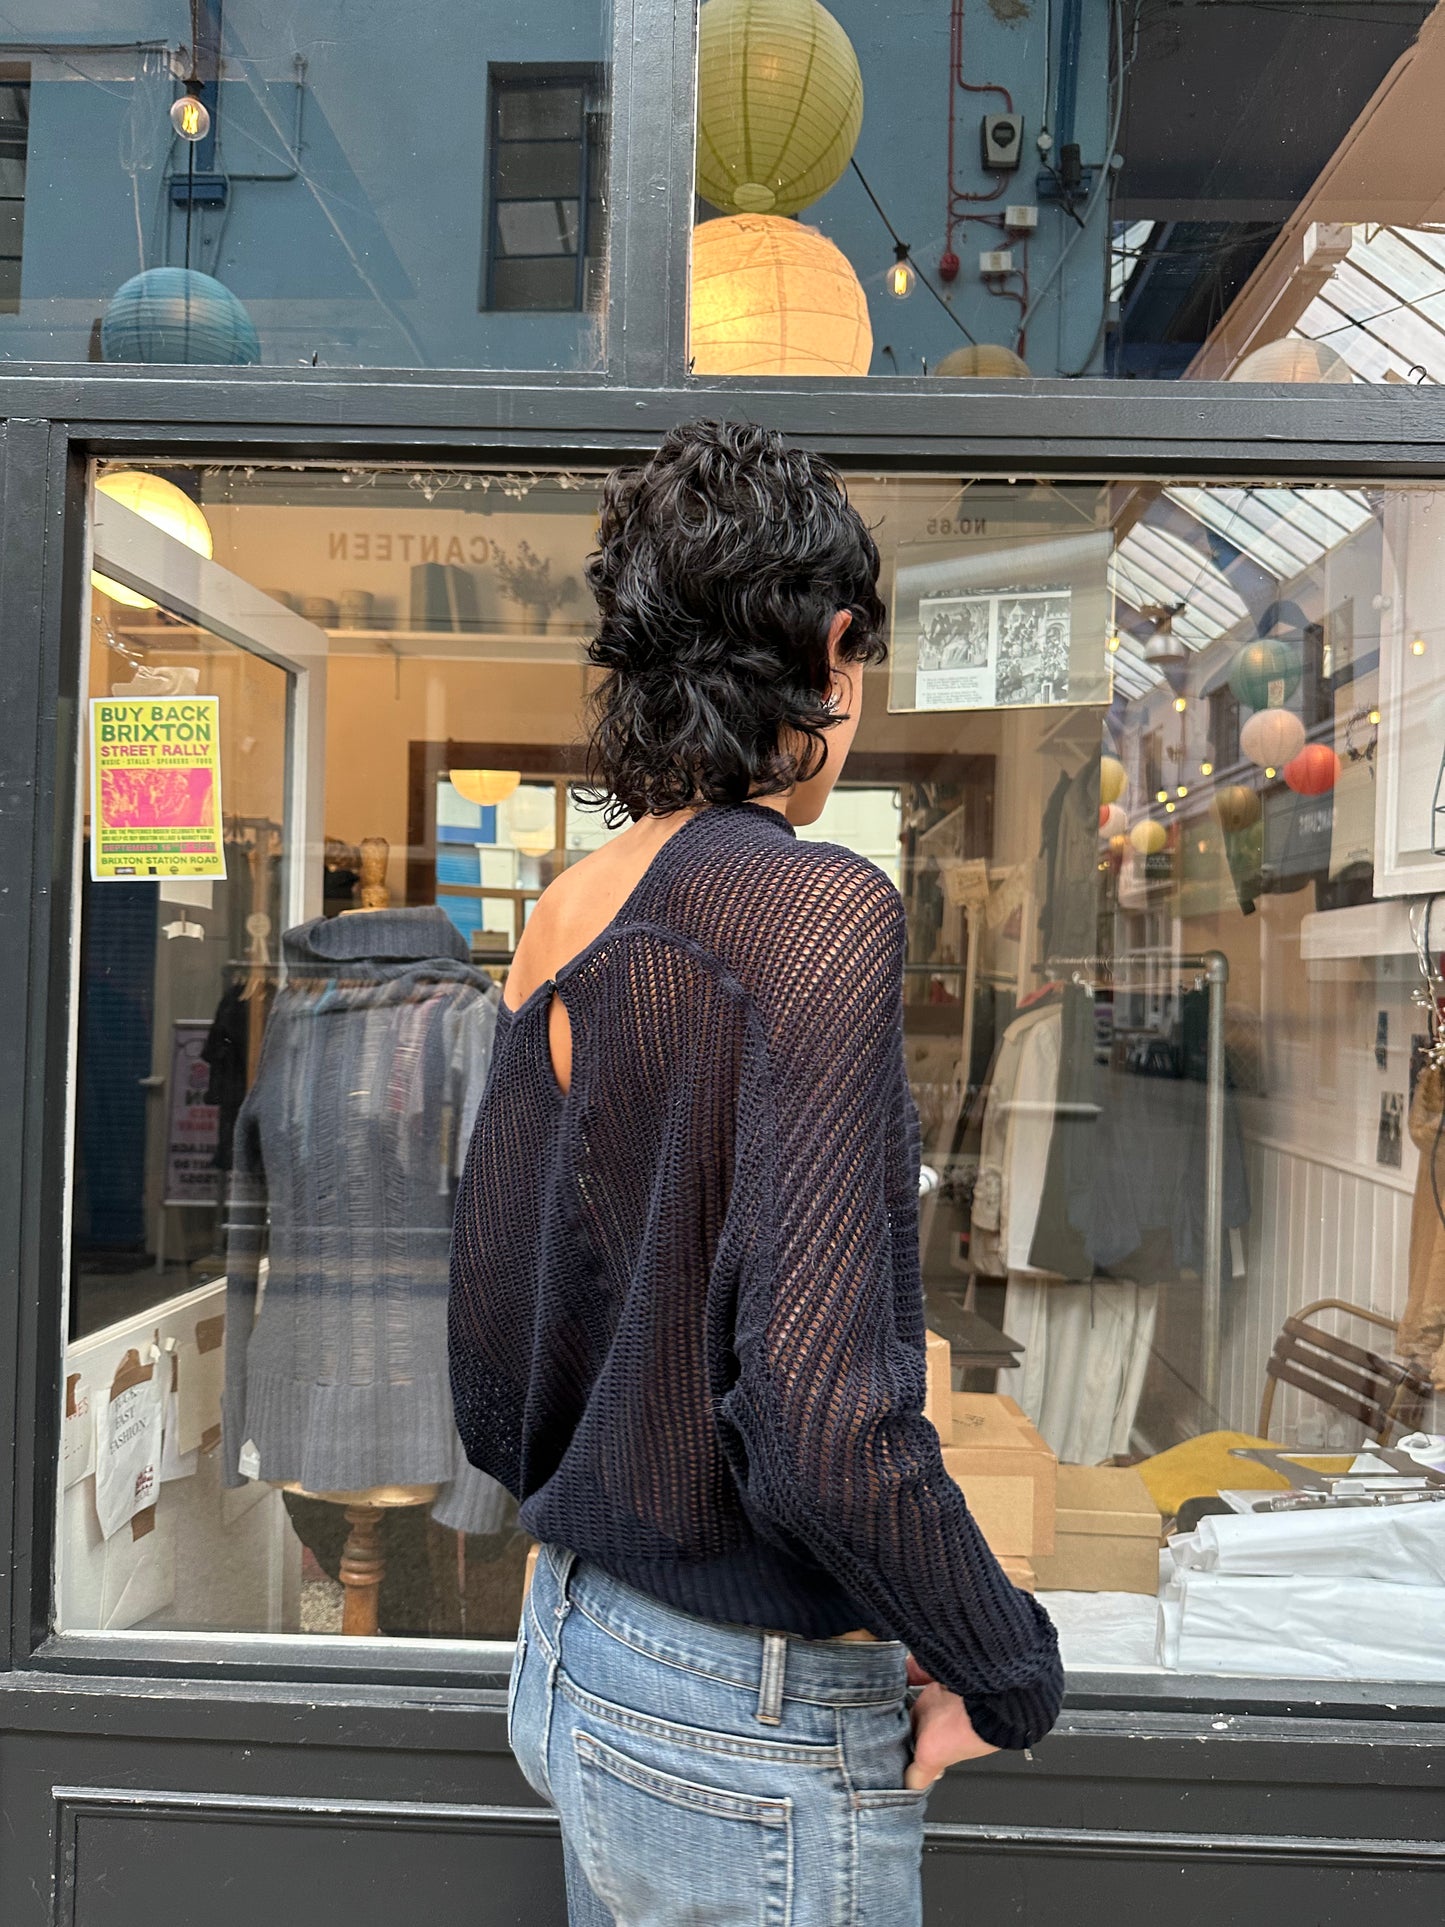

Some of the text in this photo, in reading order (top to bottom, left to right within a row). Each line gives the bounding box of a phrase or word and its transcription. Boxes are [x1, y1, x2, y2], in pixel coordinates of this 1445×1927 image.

[101, 706, 210, 722] BUY BACK
[101, 723, 211, 742] BRIXTON
[101, 744, 210, 757] STREET RALLY
[114, 1406, 135, 1430] FAST
